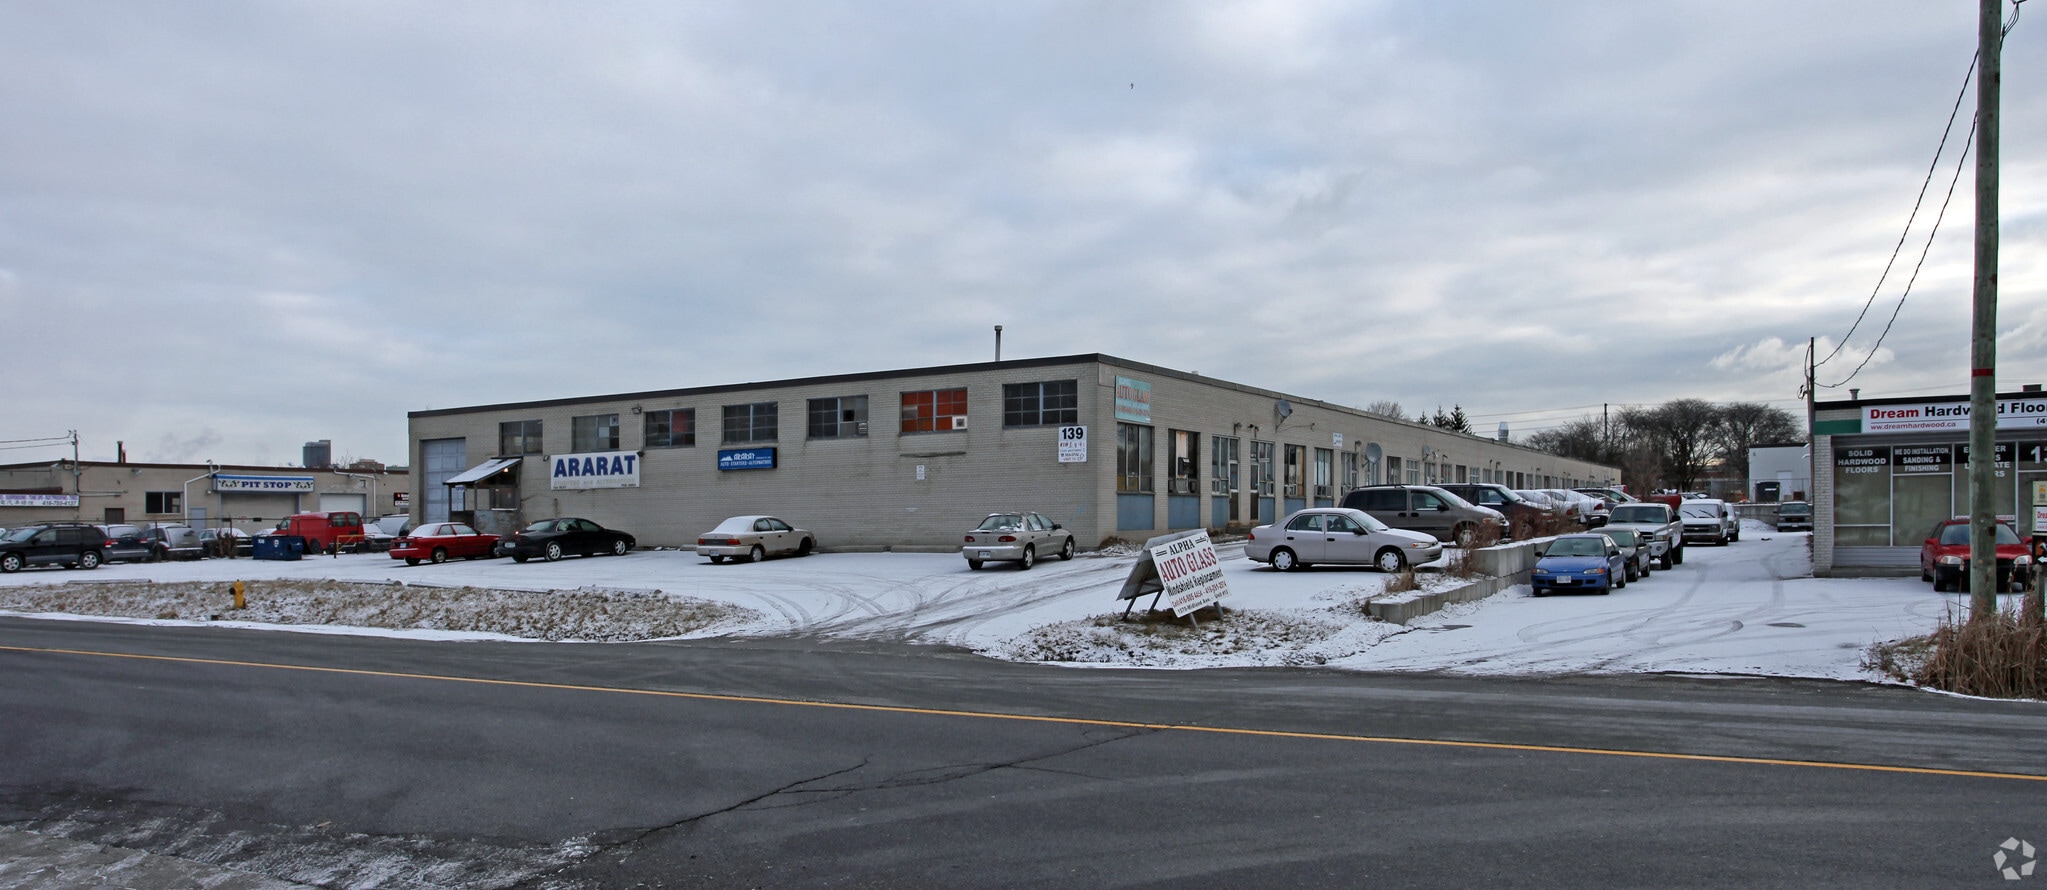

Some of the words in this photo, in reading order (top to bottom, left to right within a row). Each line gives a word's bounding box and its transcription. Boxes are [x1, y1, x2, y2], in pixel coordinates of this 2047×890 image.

[1870, 408, 1919, 419] Dream
[1924, 403, 2005, 417] Hardwd
[2011, 402, 2047, 414] Floo
[1062, 427, 1083, 439] 139
[553, 454, 636, 478] ARARAT
[1838, 458, 1887, 466] HARDWOOD
[1903, 456, 1934, 464] SANDING
[1845, 466, 1879, 474] FLOORS
[1169, 539, 1195, 555] ALPHA
[1160, 556, 1188, 582] AUTO
[1186, 547, 1217, 573] GLASS
[1165, 577, 1195, 597] Windshield
[1192, 567, 1223, 587] Replacement
